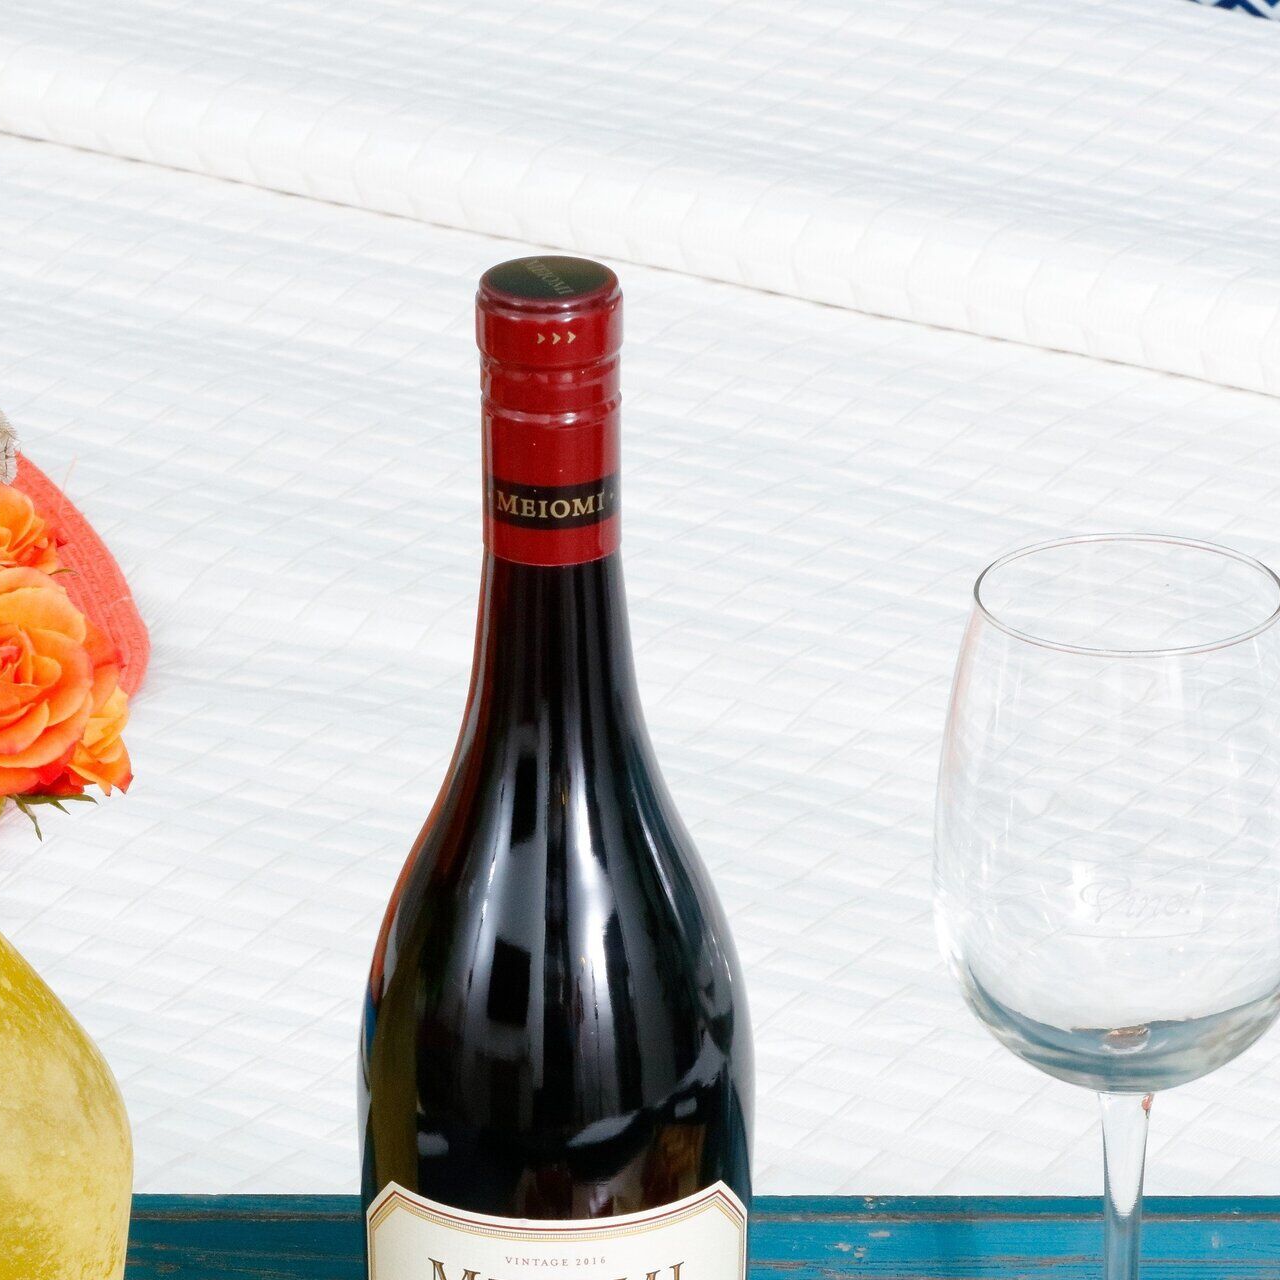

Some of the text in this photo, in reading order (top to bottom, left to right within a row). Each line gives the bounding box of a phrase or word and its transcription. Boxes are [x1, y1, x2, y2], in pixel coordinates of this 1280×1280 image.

[497, 489, 605, 519] MEIOMI
[1079, 877, 1202, 924] Vino!
[505, 1255, 606, 1267] VINTAGE 2016
